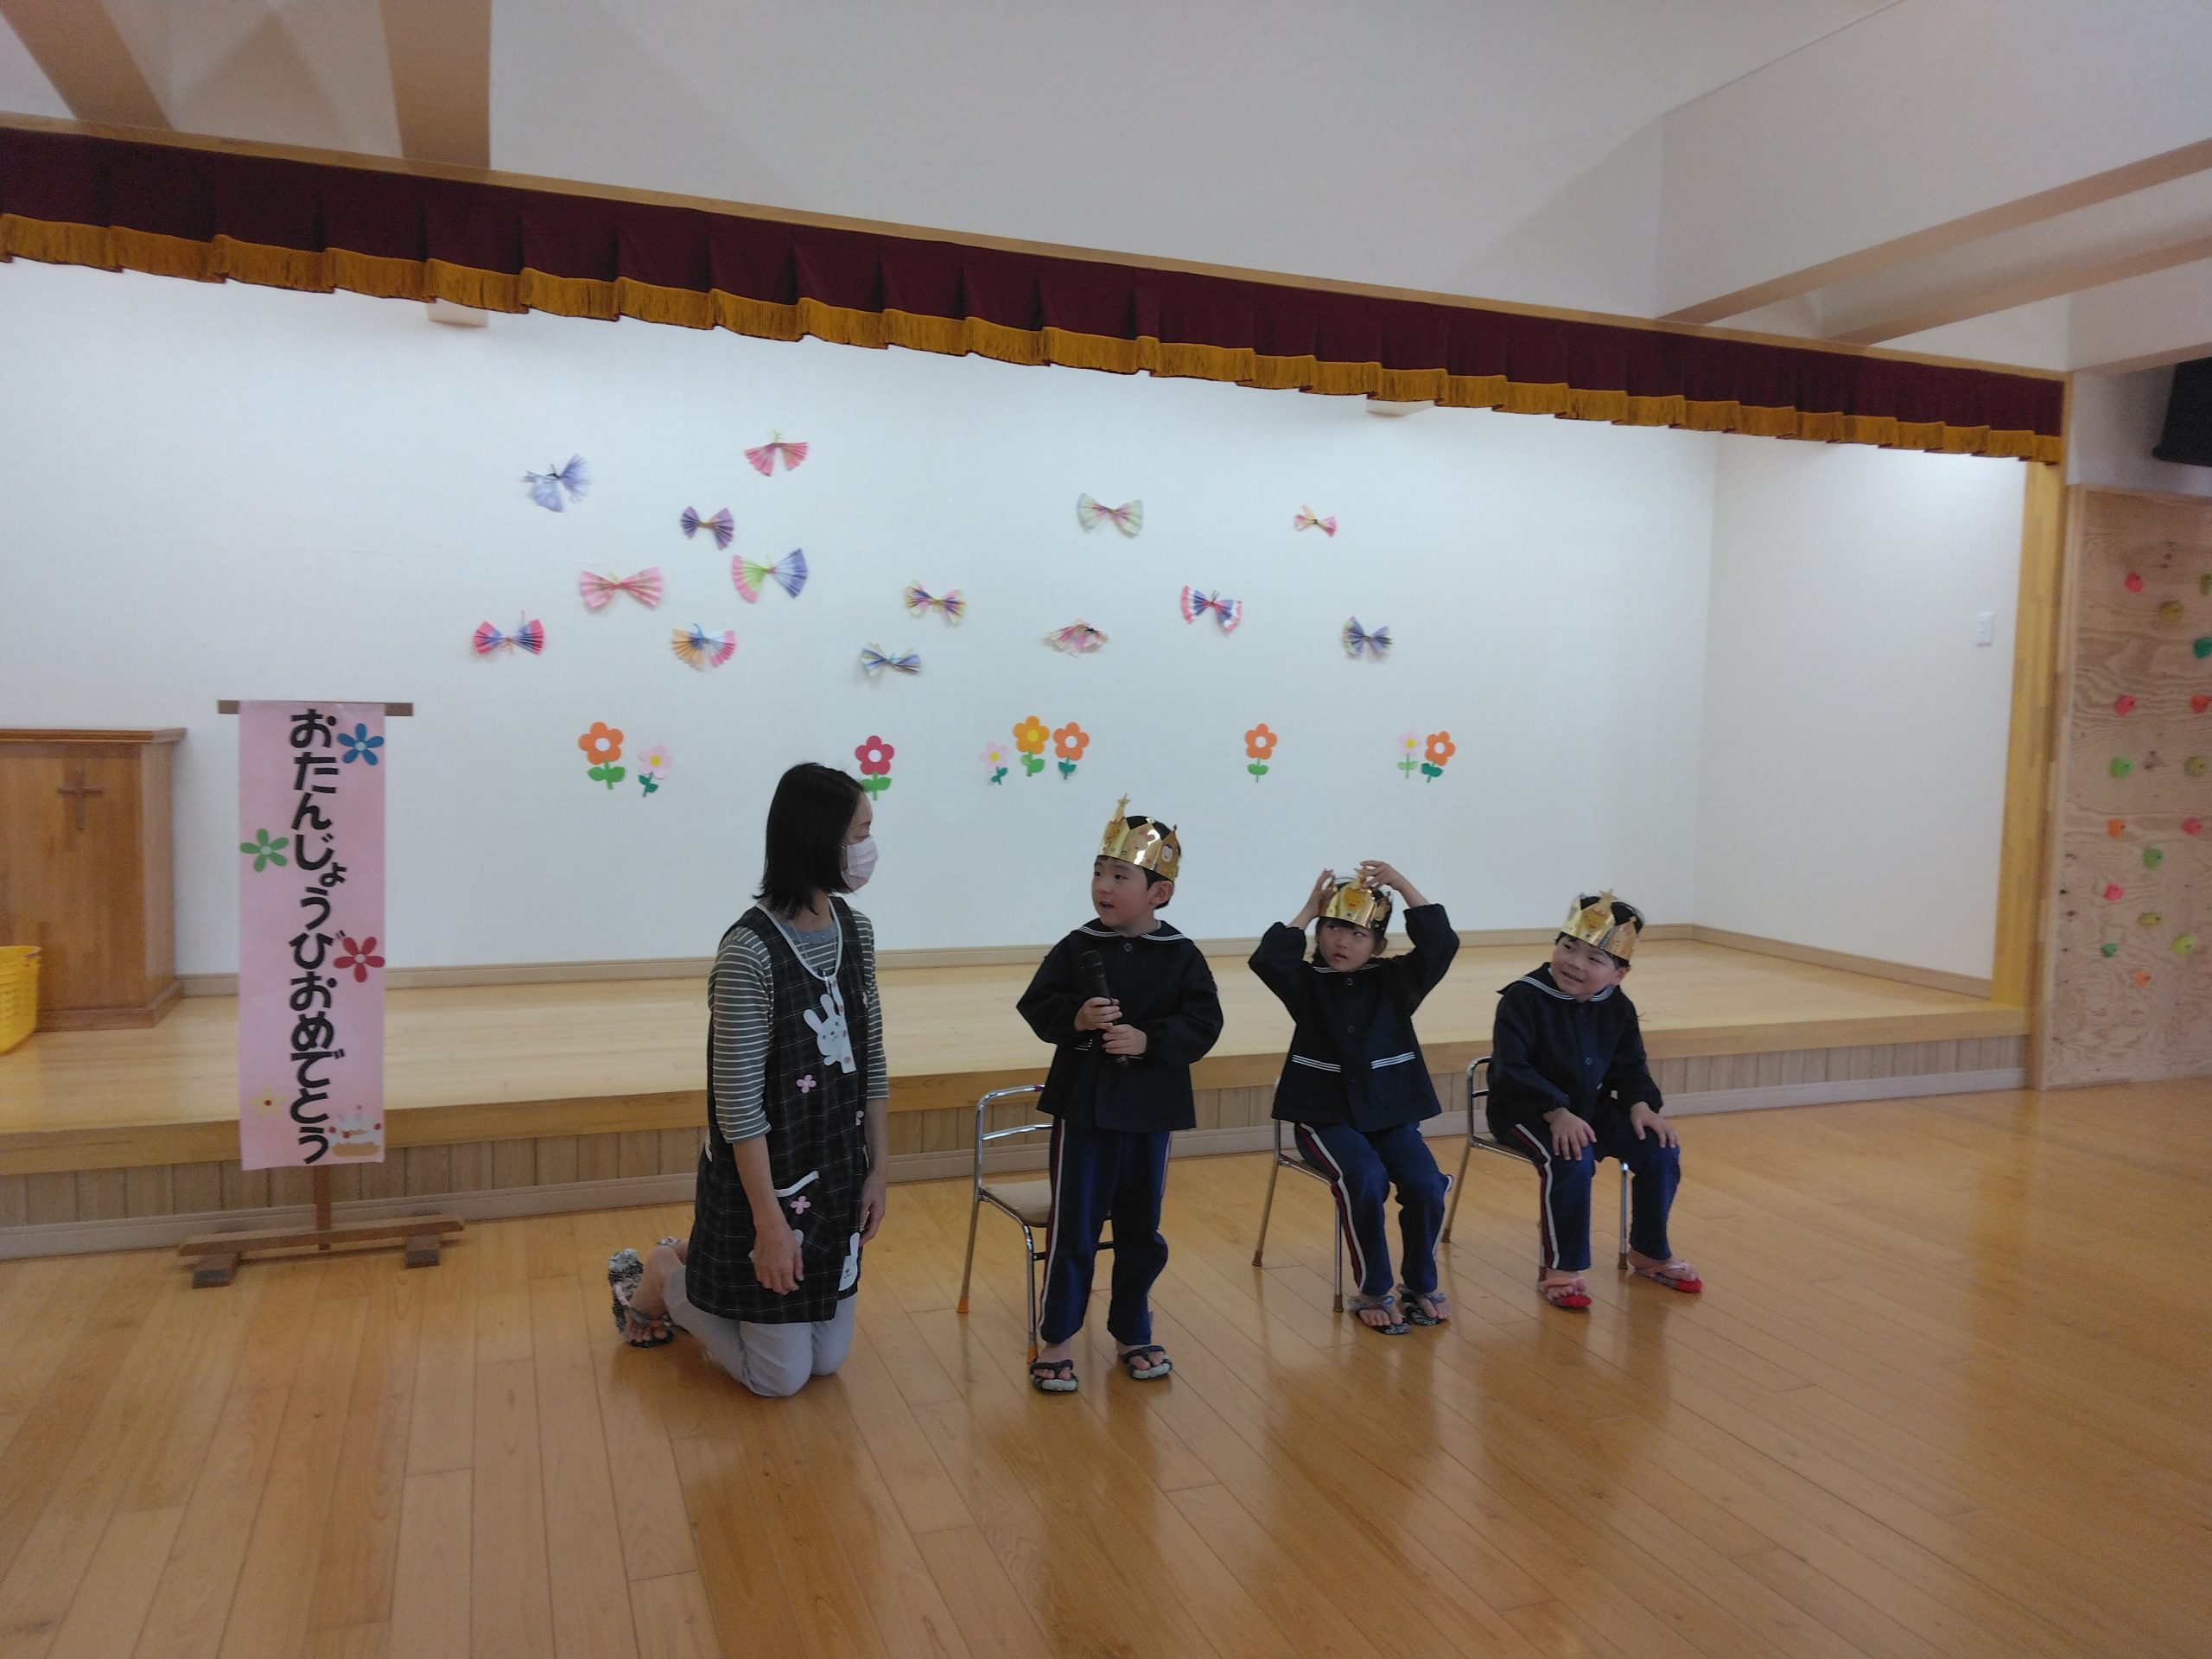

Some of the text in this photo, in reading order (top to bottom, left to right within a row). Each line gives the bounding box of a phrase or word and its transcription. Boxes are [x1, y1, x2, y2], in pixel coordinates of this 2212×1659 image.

[289, 709, 346, 1164] おたんじょうびおめでとう
